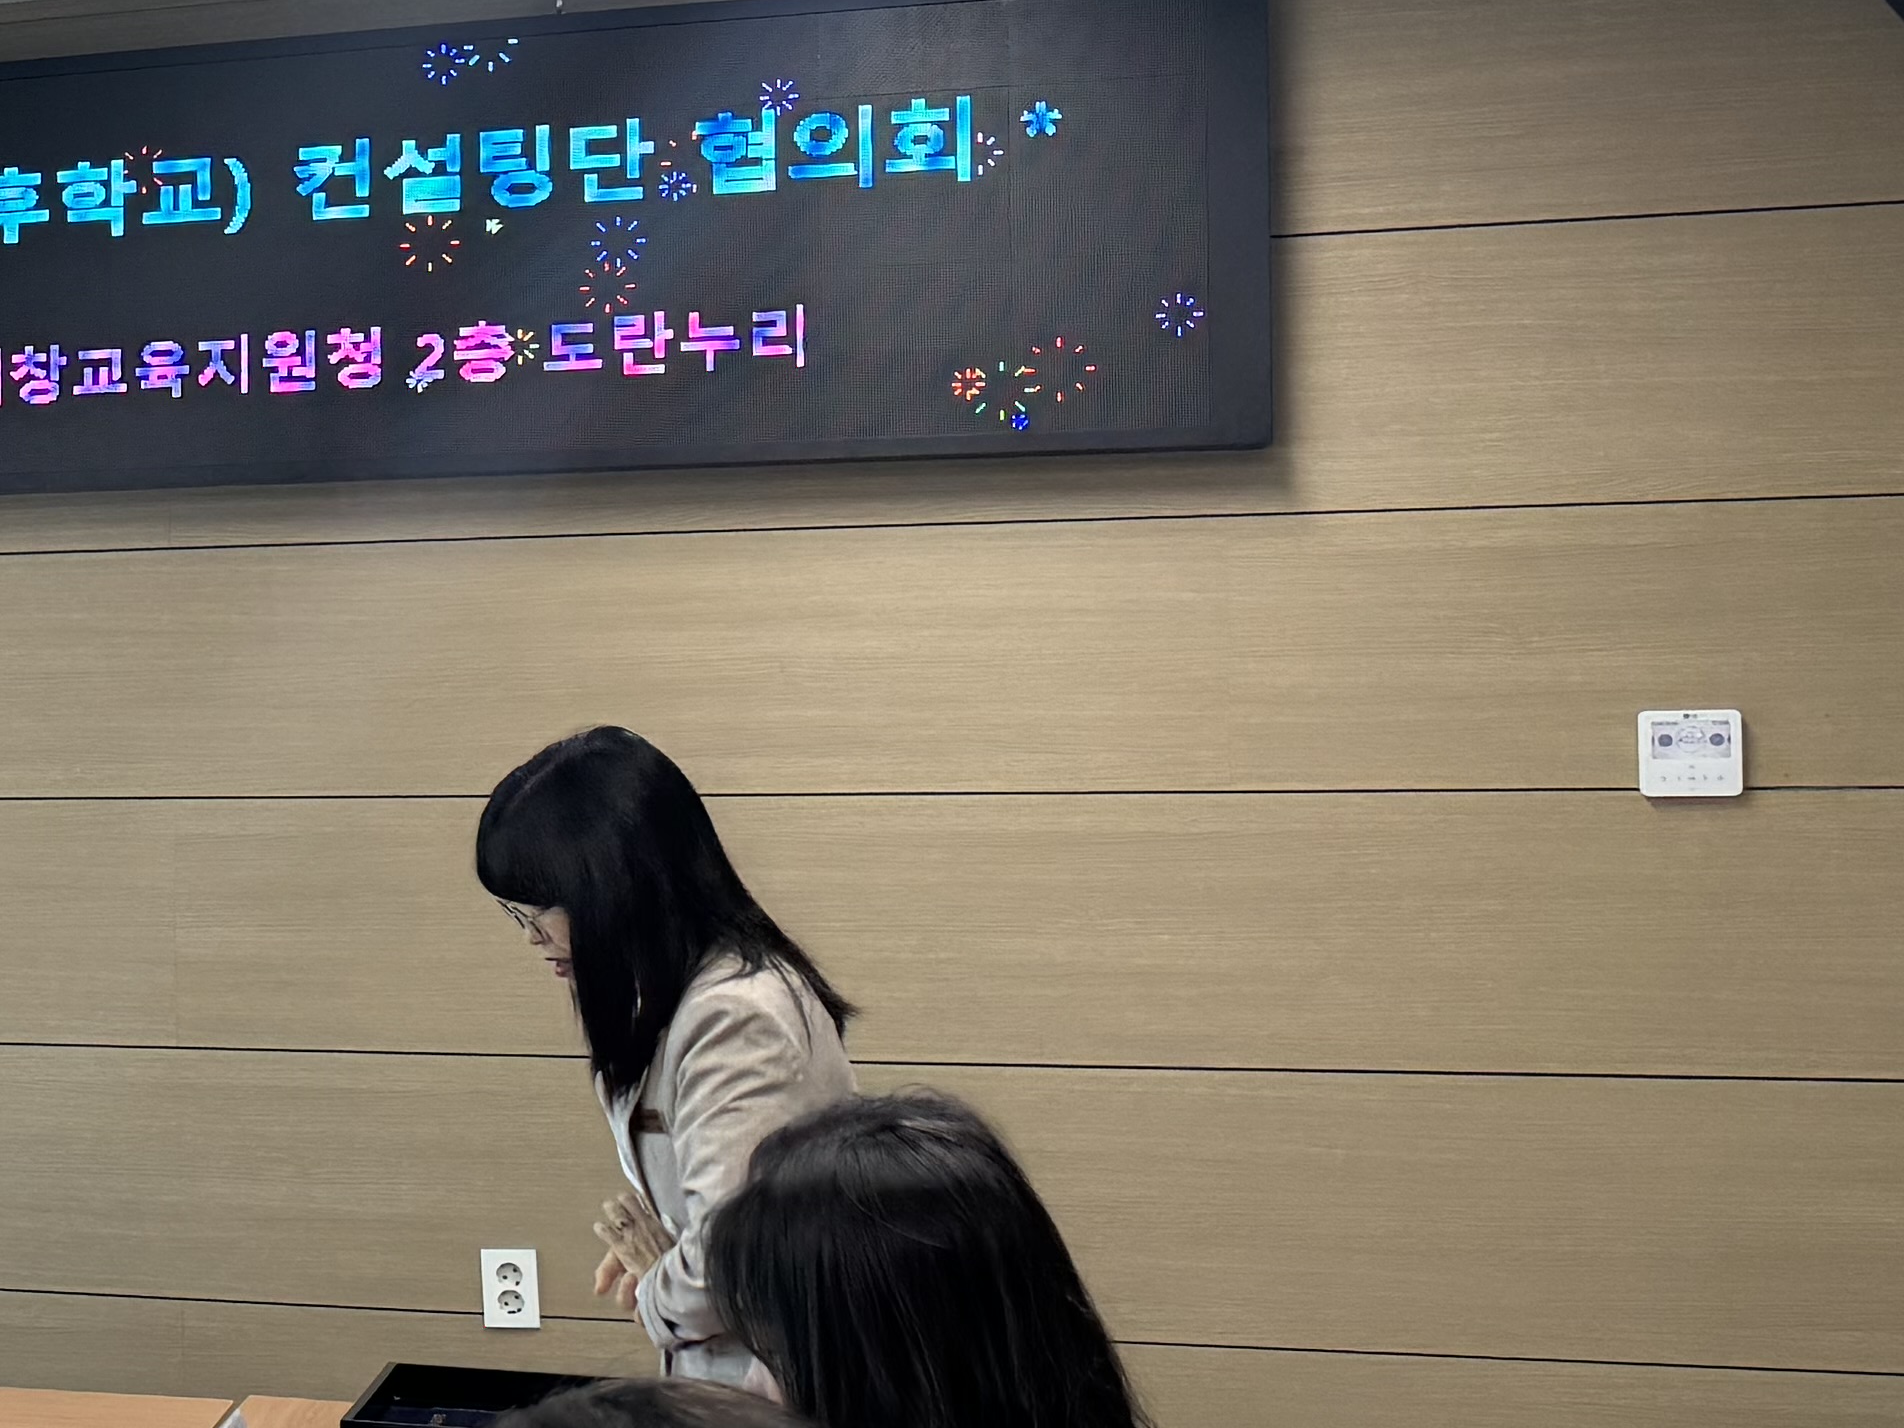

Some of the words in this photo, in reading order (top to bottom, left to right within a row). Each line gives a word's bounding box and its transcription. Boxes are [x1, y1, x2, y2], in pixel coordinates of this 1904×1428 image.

[293, 117, 655, 220] 컨설팅단
[694, 95, 972, 196] 협의회
[414, 322, 515, 387] 2층
[542, 303, 807, 376] 도란누리
